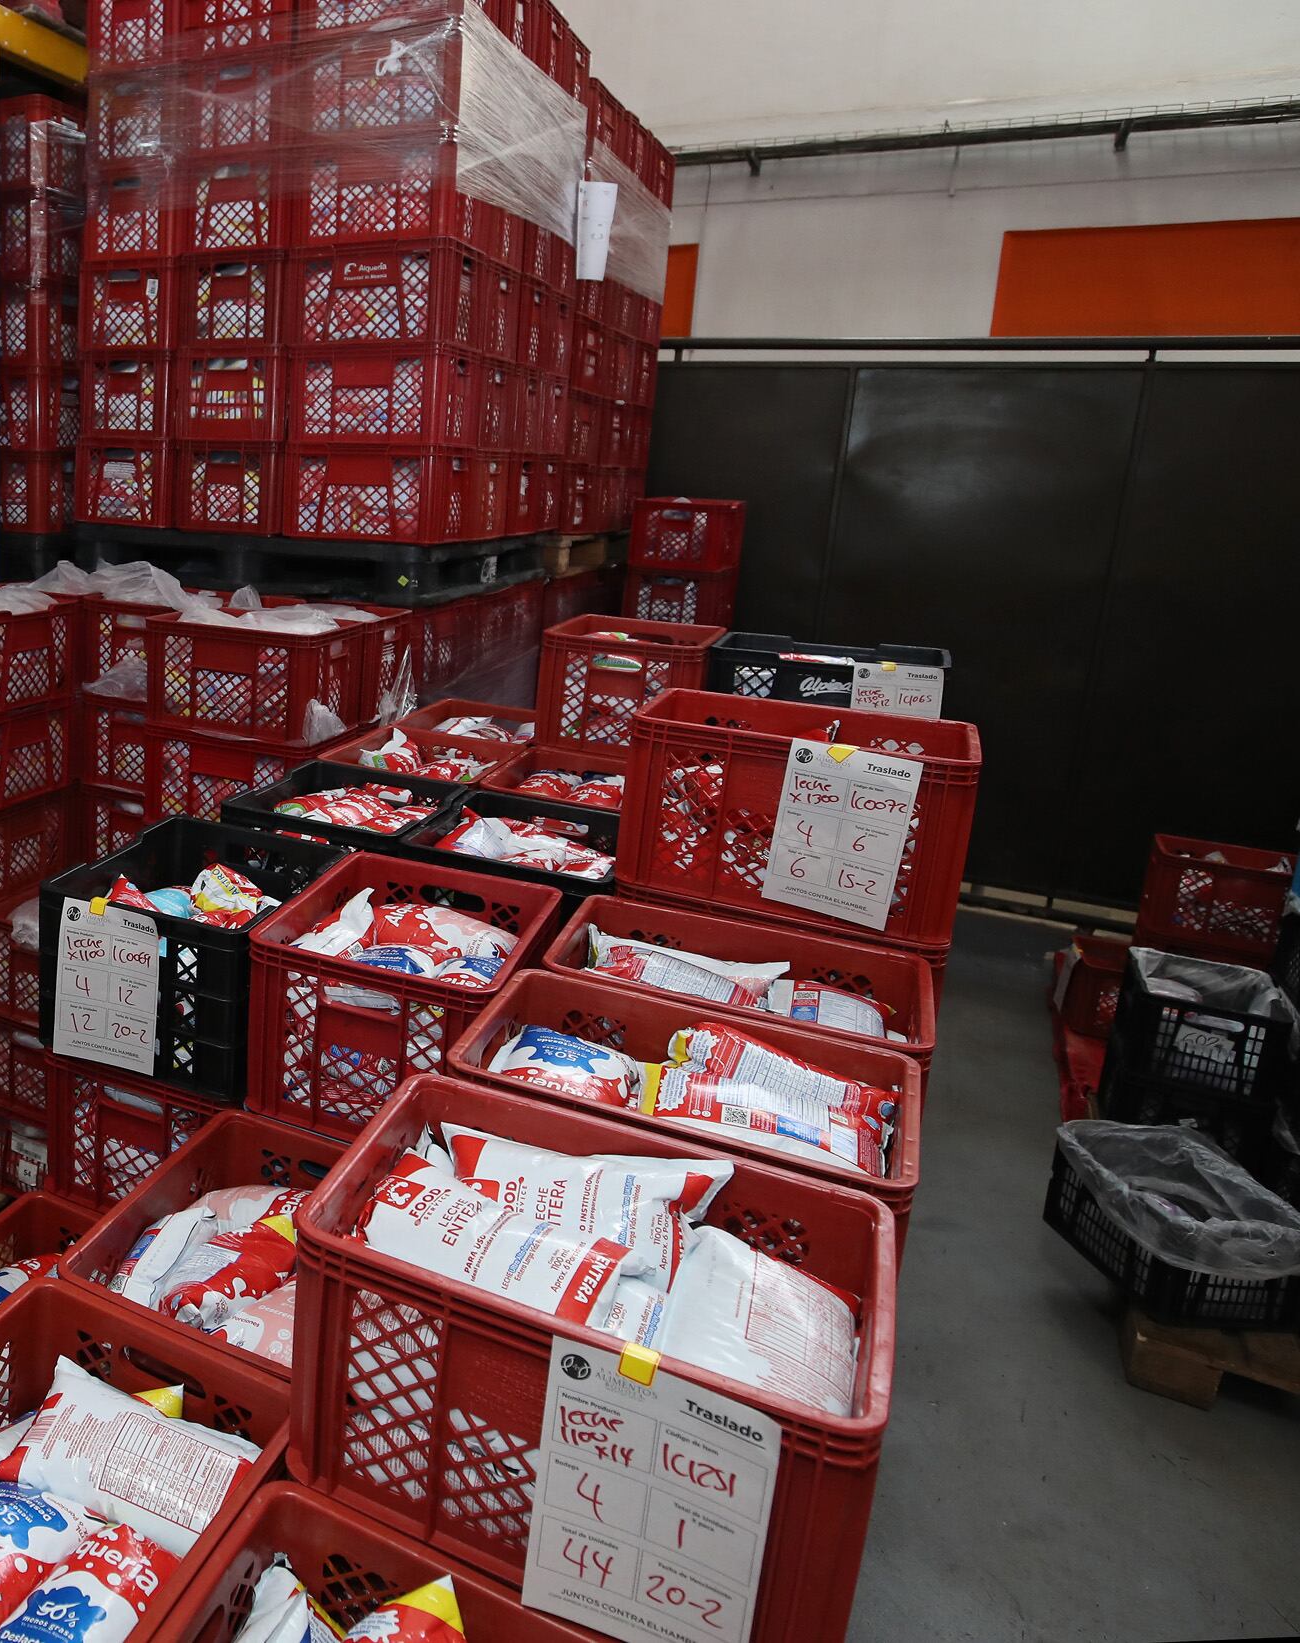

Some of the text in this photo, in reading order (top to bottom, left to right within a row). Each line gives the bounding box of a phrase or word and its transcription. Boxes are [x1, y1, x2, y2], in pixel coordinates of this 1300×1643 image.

[907, 672, 938, 680] Traslado
[867, 763, 911, 779] Traslado
[797, 820, 813, 847] 4
[852, 835, 866, 851] 6
[790, 856, 807, 878] 6
[784, 885, 808, 894] JUNTOS
[808, 891, 833, 902] CONTRA
[122, 918, 155, 934] Traslado
[75, 974, 91, 997] 4
[118, 986, 136, 1006] 12
[70, 1012, 96, 1032] 12
[111, 1022, 149, 1044] 20-2
[71, 1039, 90, 1048] JUNTOS
[90, 1043, 111, 1053] CONTRA
[408, 1188, 442, 1219] FOOD
[503, 1180, 517, 1212] OOD
[535, 1186, 549, 1221] ECHE
[548, 1179, 568, 1226] TERA
[438, 1197, 468, 1228] LECHE
[442, 1200, 483, 1247] ENTERA
[463, 1251, 478, 1274] PARA
[659, 1242, 669, 1270] Aprox.
[501, 1272, 512, 1291] LECHE
[550, 1269, 567, 1293] Aprox.
[574, 1255, 612, 1304] ENTERA
[561, 1392, 621, 1417] Nombre Producto
[686, 1399, 763, 1443] Traslado
[665, 1429, 690, 1443] Código
[554, 1458, 580, 1472] Bodega
[576, 1472, 603, 1523] 4
[673, 1501, 691, 1513] Total
[702, 1513, 736, 1535] Unidades
[561, 1525, 577, 1536] Total
[588, 1534, 619, 1551] Unidades
[677, 1519, 685, 1549] 1
[74, 1540, 159, 1597] quería
[562, 1538, 614, 1588] 44
[679, 1570, 688, 1578] de
[36, 1601, 82, 1628] 50%
[560, 1588, 662, 1633] JUNTOS CONTRA EL
[646, 1575, 724, 1630] 20-2
[22, 1615, 75, 1640] menos grasa
